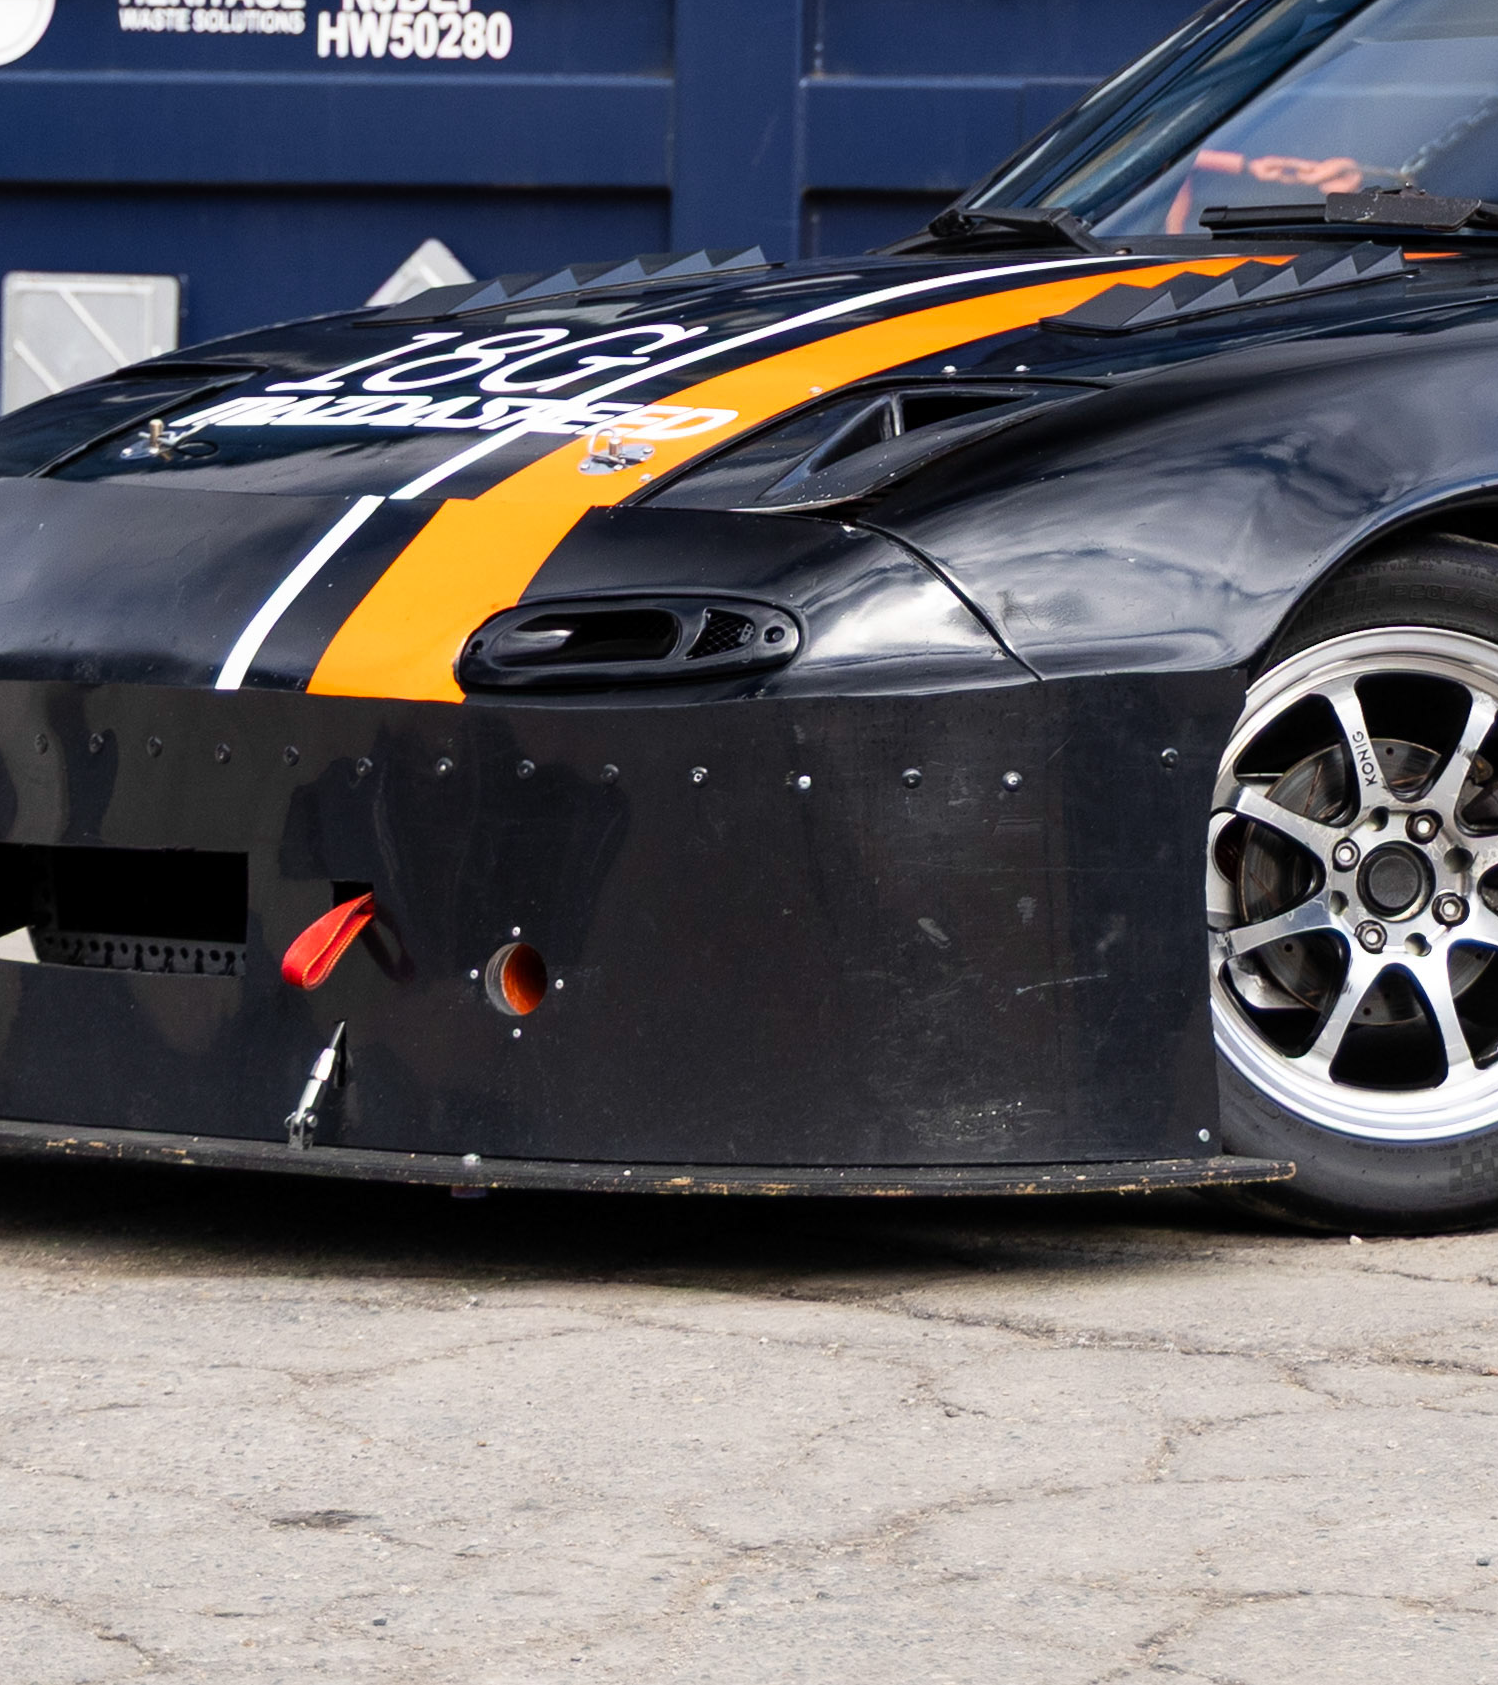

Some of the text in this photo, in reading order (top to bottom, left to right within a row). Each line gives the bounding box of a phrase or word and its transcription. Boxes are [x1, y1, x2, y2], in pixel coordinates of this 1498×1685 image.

[119, 8, 306, 34] WASTE SOLUTIONS
[317, 11, 513, 59] HW50280
[264, 323, 709, 394] 18G
[1352, 730, 1379, 787] KONIG
